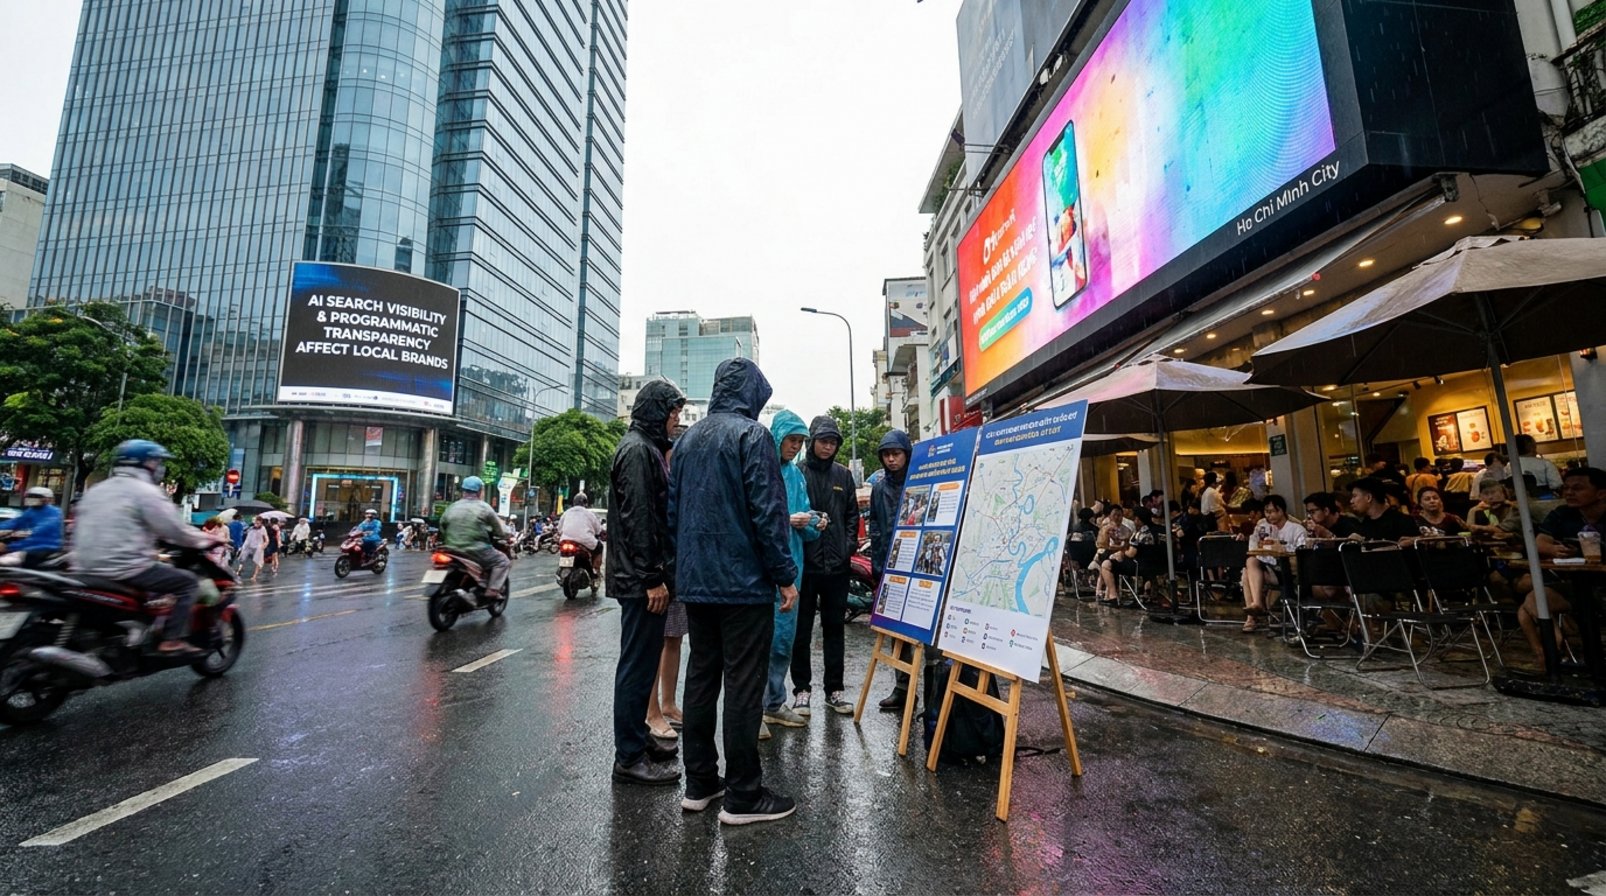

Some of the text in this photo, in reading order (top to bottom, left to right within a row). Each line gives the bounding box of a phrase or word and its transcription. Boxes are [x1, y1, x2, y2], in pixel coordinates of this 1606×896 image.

[1236, 217, 1253, 236] Ho
[1254, 199, 1275, 223] Chi
[1311, 160, 1340, 187] City
[308, 294, 447, 325] AI SEARCH VISIBILITY
[316, 311, 439, 338] & PROGRAMMATIC
[323, 326, 431, 351] TRANSPARENCY
[295, 341, 449, 370] AFFECT LOCAL BRANDS
